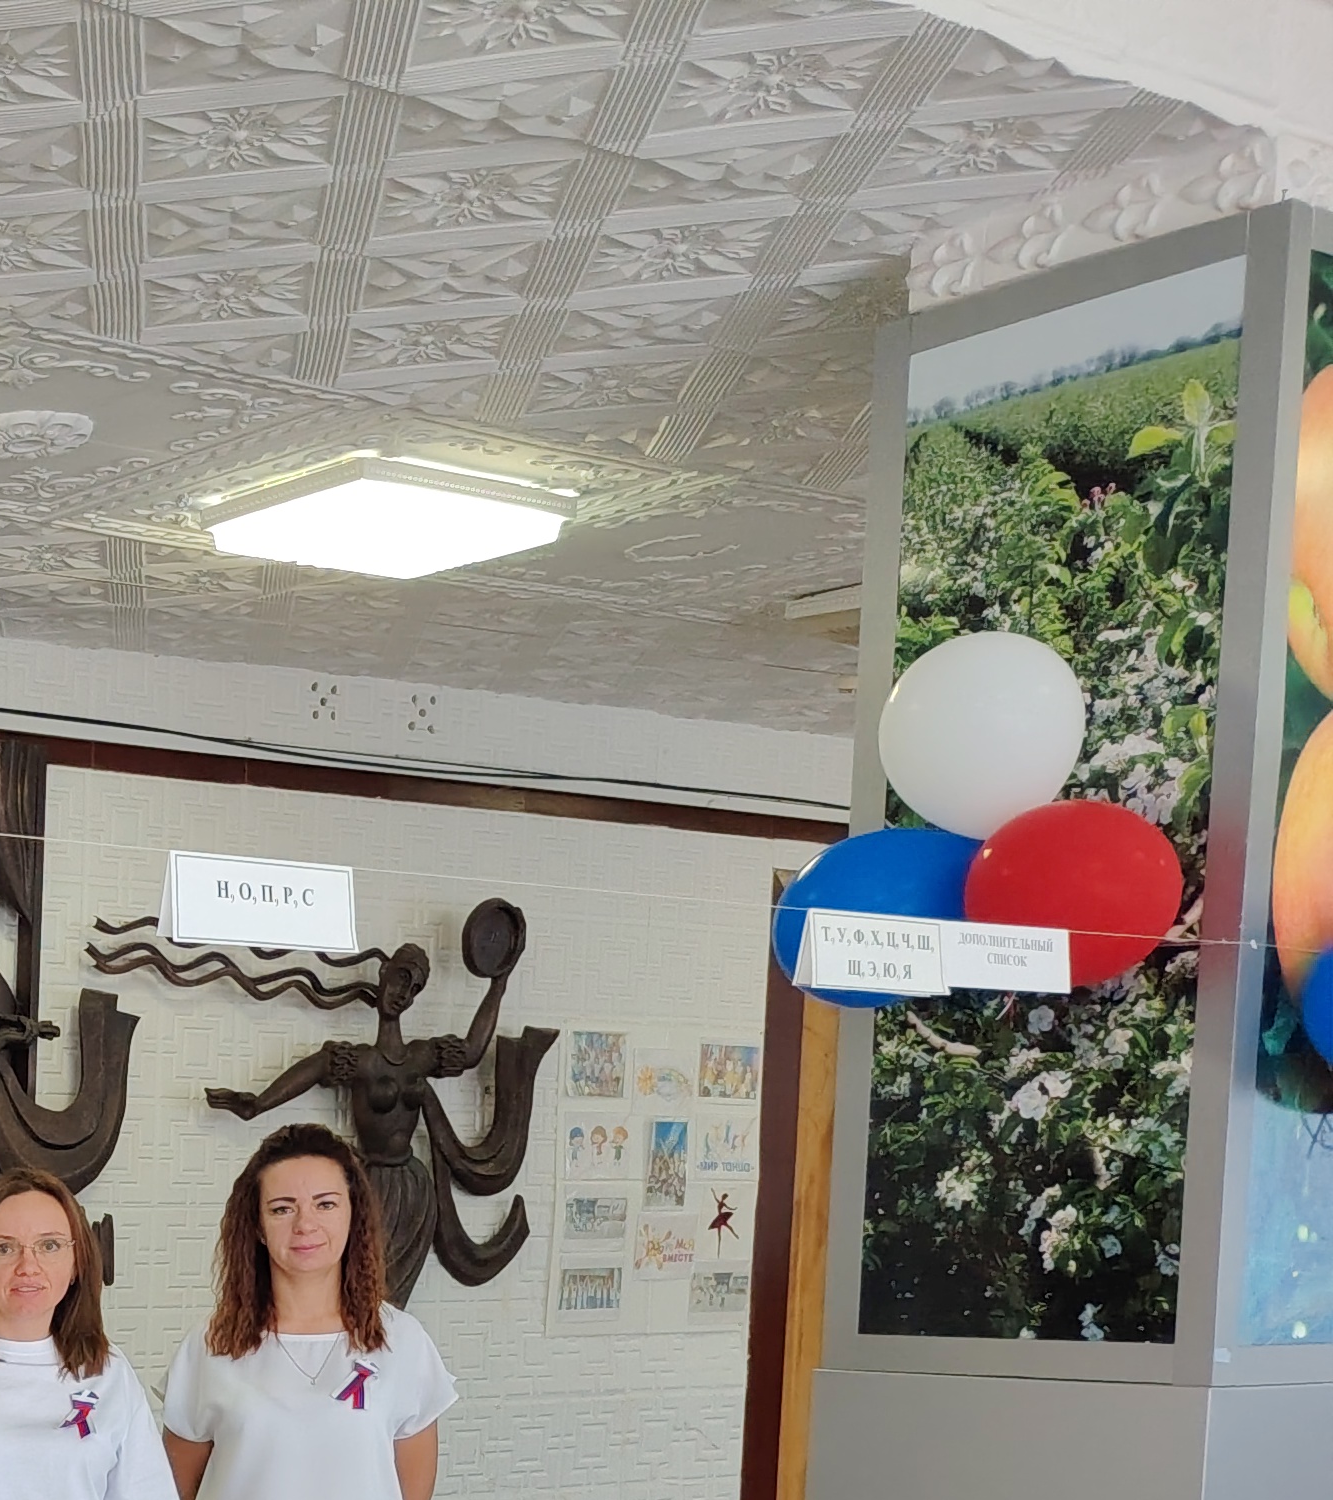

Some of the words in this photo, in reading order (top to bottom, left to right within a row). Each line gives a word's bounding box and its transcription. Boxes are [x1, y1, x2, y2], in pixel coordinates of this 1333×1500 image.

[216, 880, 235, 903] Н,
[239, 882, 257, 905] О,
[261, 884, 279, 907] П,
[283, 886, 299, 908] Р,
[302, 888, 314, 907] С
[958, 932, 1053, 952] ДОПОЛНИТЕЛЬНЫЙ
[987, 952, 1027, 967] СПИСОК
[903, 964, 913, 980] Я
